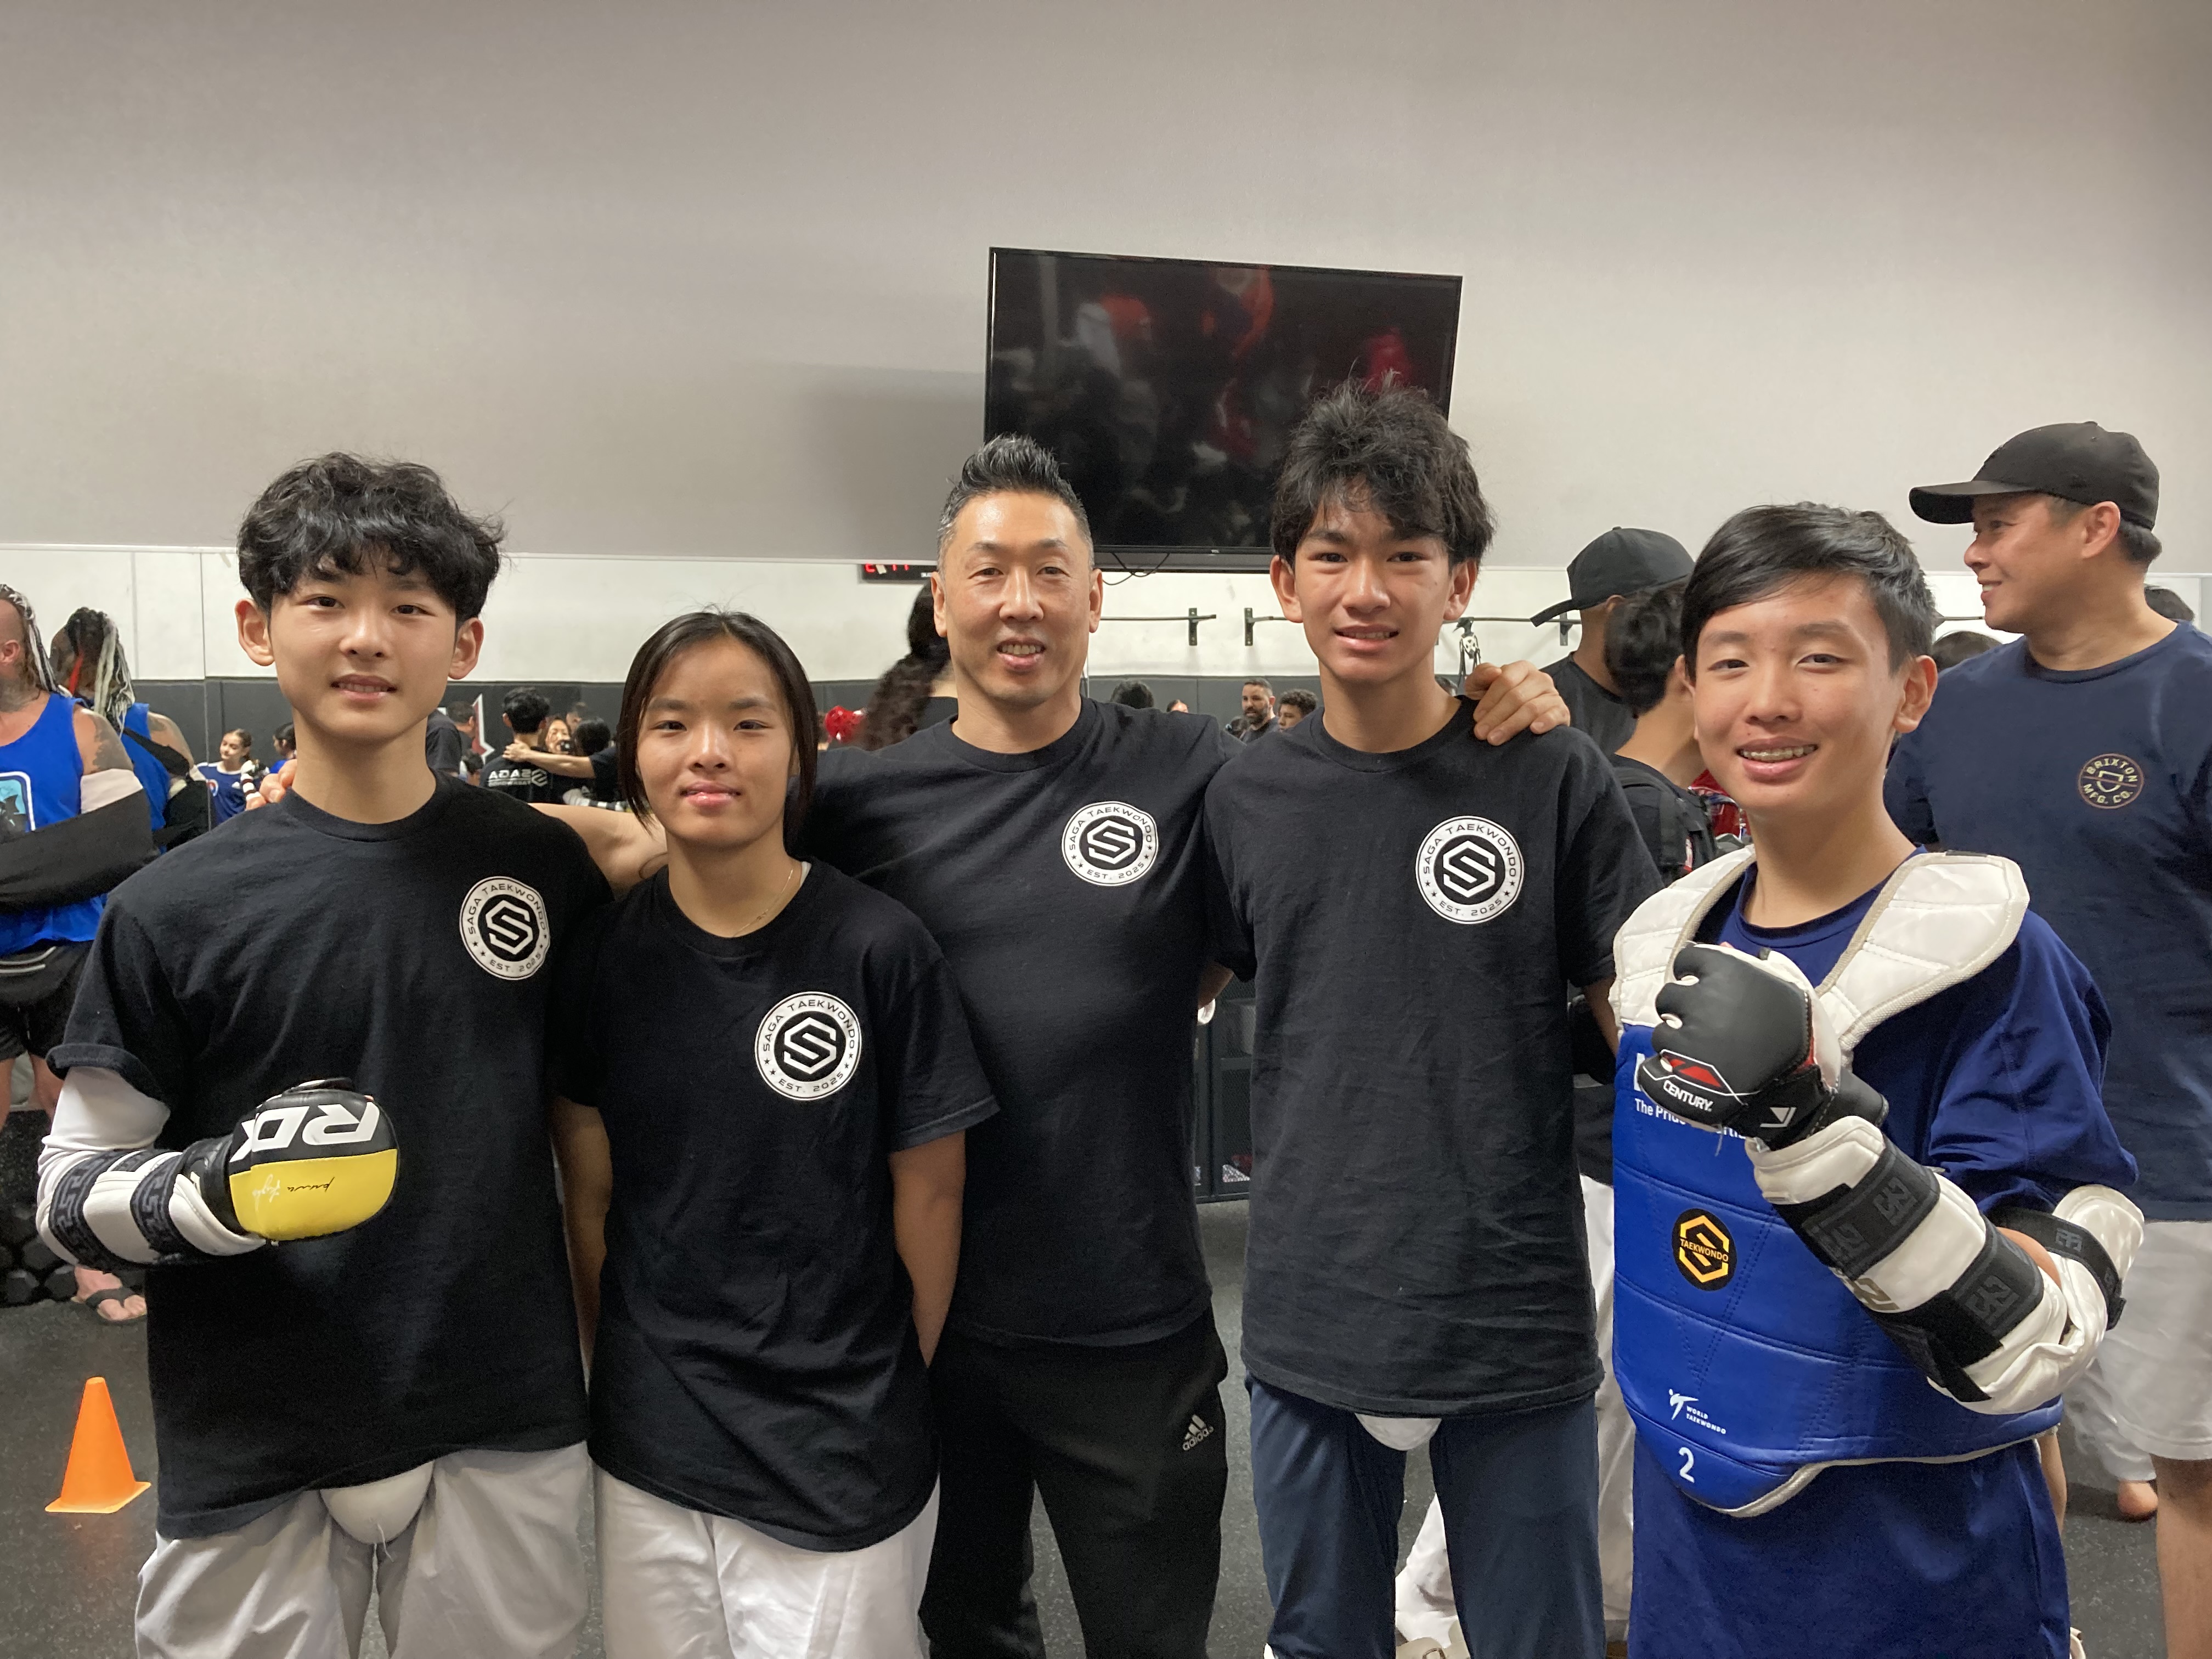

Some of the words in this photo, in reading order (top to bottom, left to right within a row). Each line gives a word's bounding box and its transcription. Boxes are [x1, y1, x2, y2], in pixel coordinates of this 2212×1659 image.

[2086, 758, 2138, 782] BRIXTON
[1069, 820, 1086, 850] SAGA
[1087, 806, 1152, 843] TAEKWONDO
[1423, 838, 1442, 874] SAGA
[1445, 823, 1516, 877] TAEKWONDO
[1118, 862, 1144, 879] 2025
[467, 898, 482, 934] SAGA
[482, 883, 546, 930] TAEKWONDO
[1471, 898, 1502, 916] 2025
[763, 1015, 784, 1052] SAGA
[787, 999, 855, 1049] TAEKWONDO
[813, 1071, 844, 1092] 2025
[1635, 1097, 1654, 1116] The
[1663, 1080, 1714, 1111] CENTURY
[1680, 1238, 1729, 1262] TAEKWONDO
[1686, 1405, 1708, 1420] WORLD
[1686, 1413, 1726, 1435] TAEKWONDO
[1182, 1426, 1214, 1451] adidas
[1679, 1447, 1695, 1483] 2
